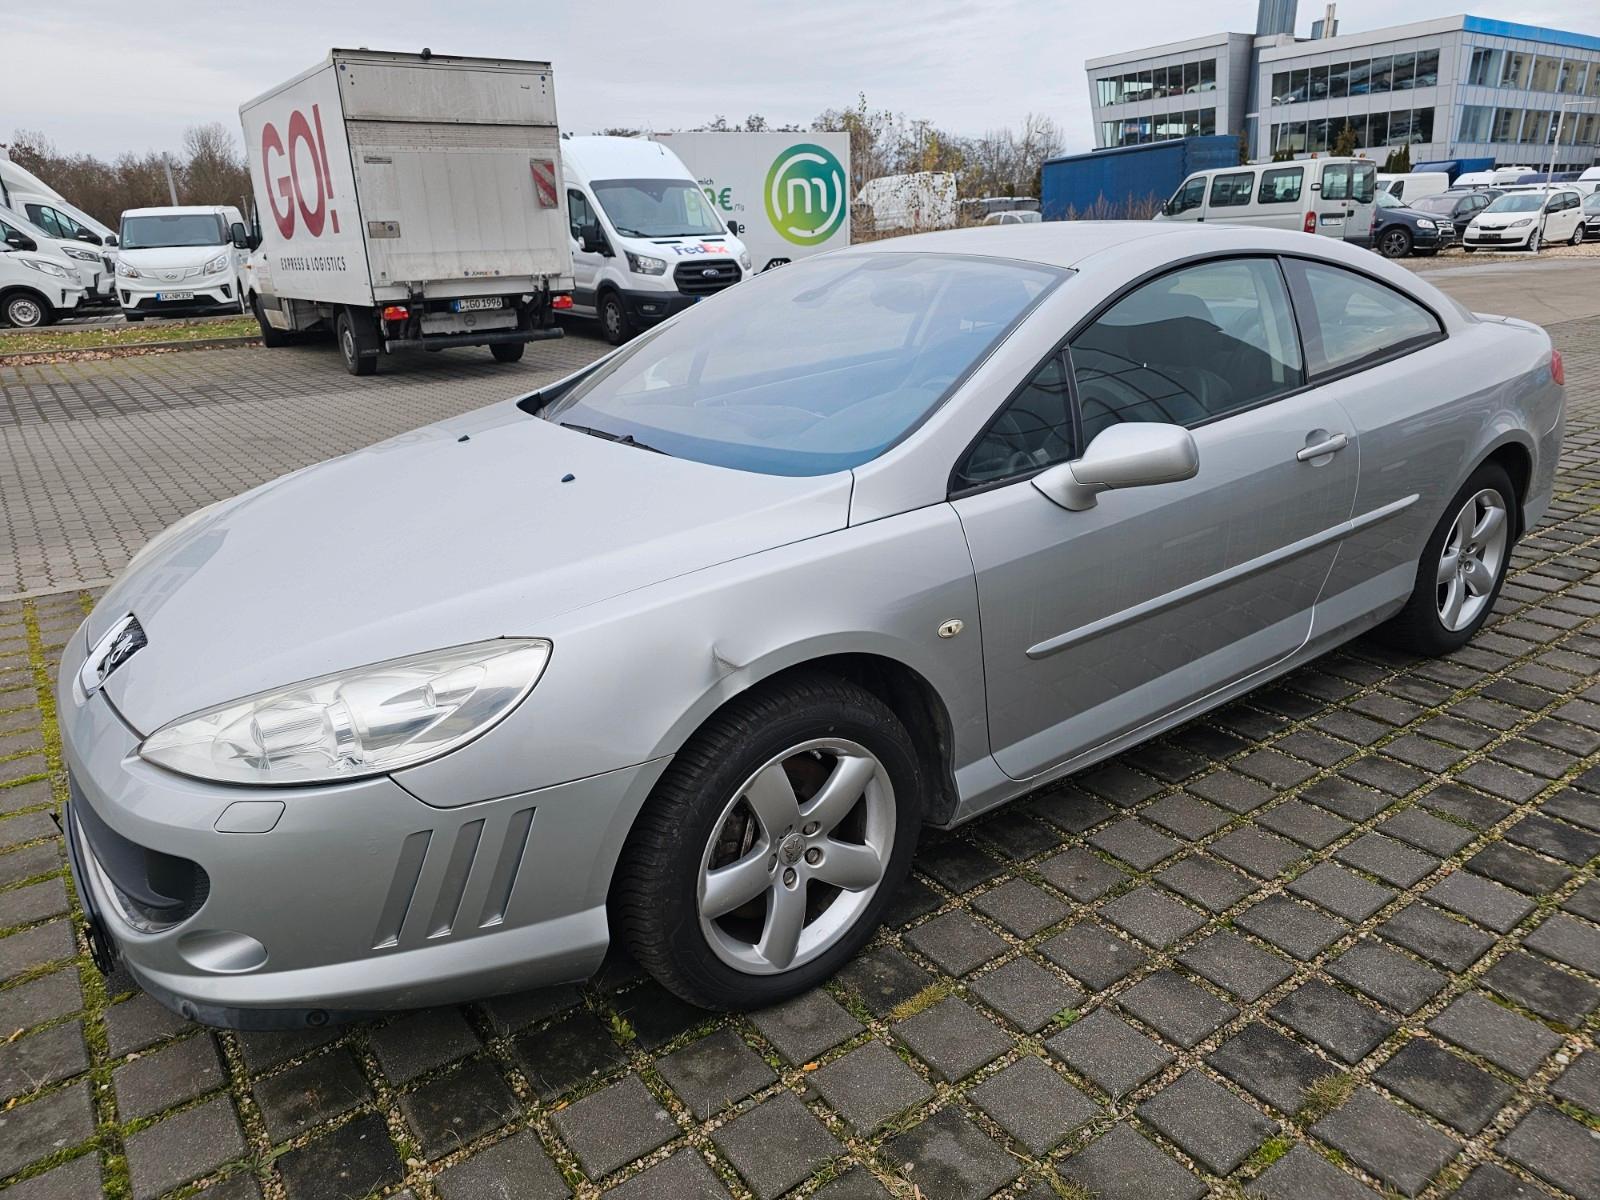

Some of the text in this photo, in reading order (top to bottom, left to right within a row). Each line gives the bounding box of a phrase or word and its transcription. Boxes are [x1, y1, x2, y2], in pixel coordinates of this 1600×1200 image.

[262, 104, 340, 240] GO!
[671, 244, 730, 256] FedEx
[280, 257, 305, 271] EXPRESS
[305, 257, 311, 271] &
[310, 256, 346, 271] LOGISTICS
[481, 296, 502, 308] 1996
